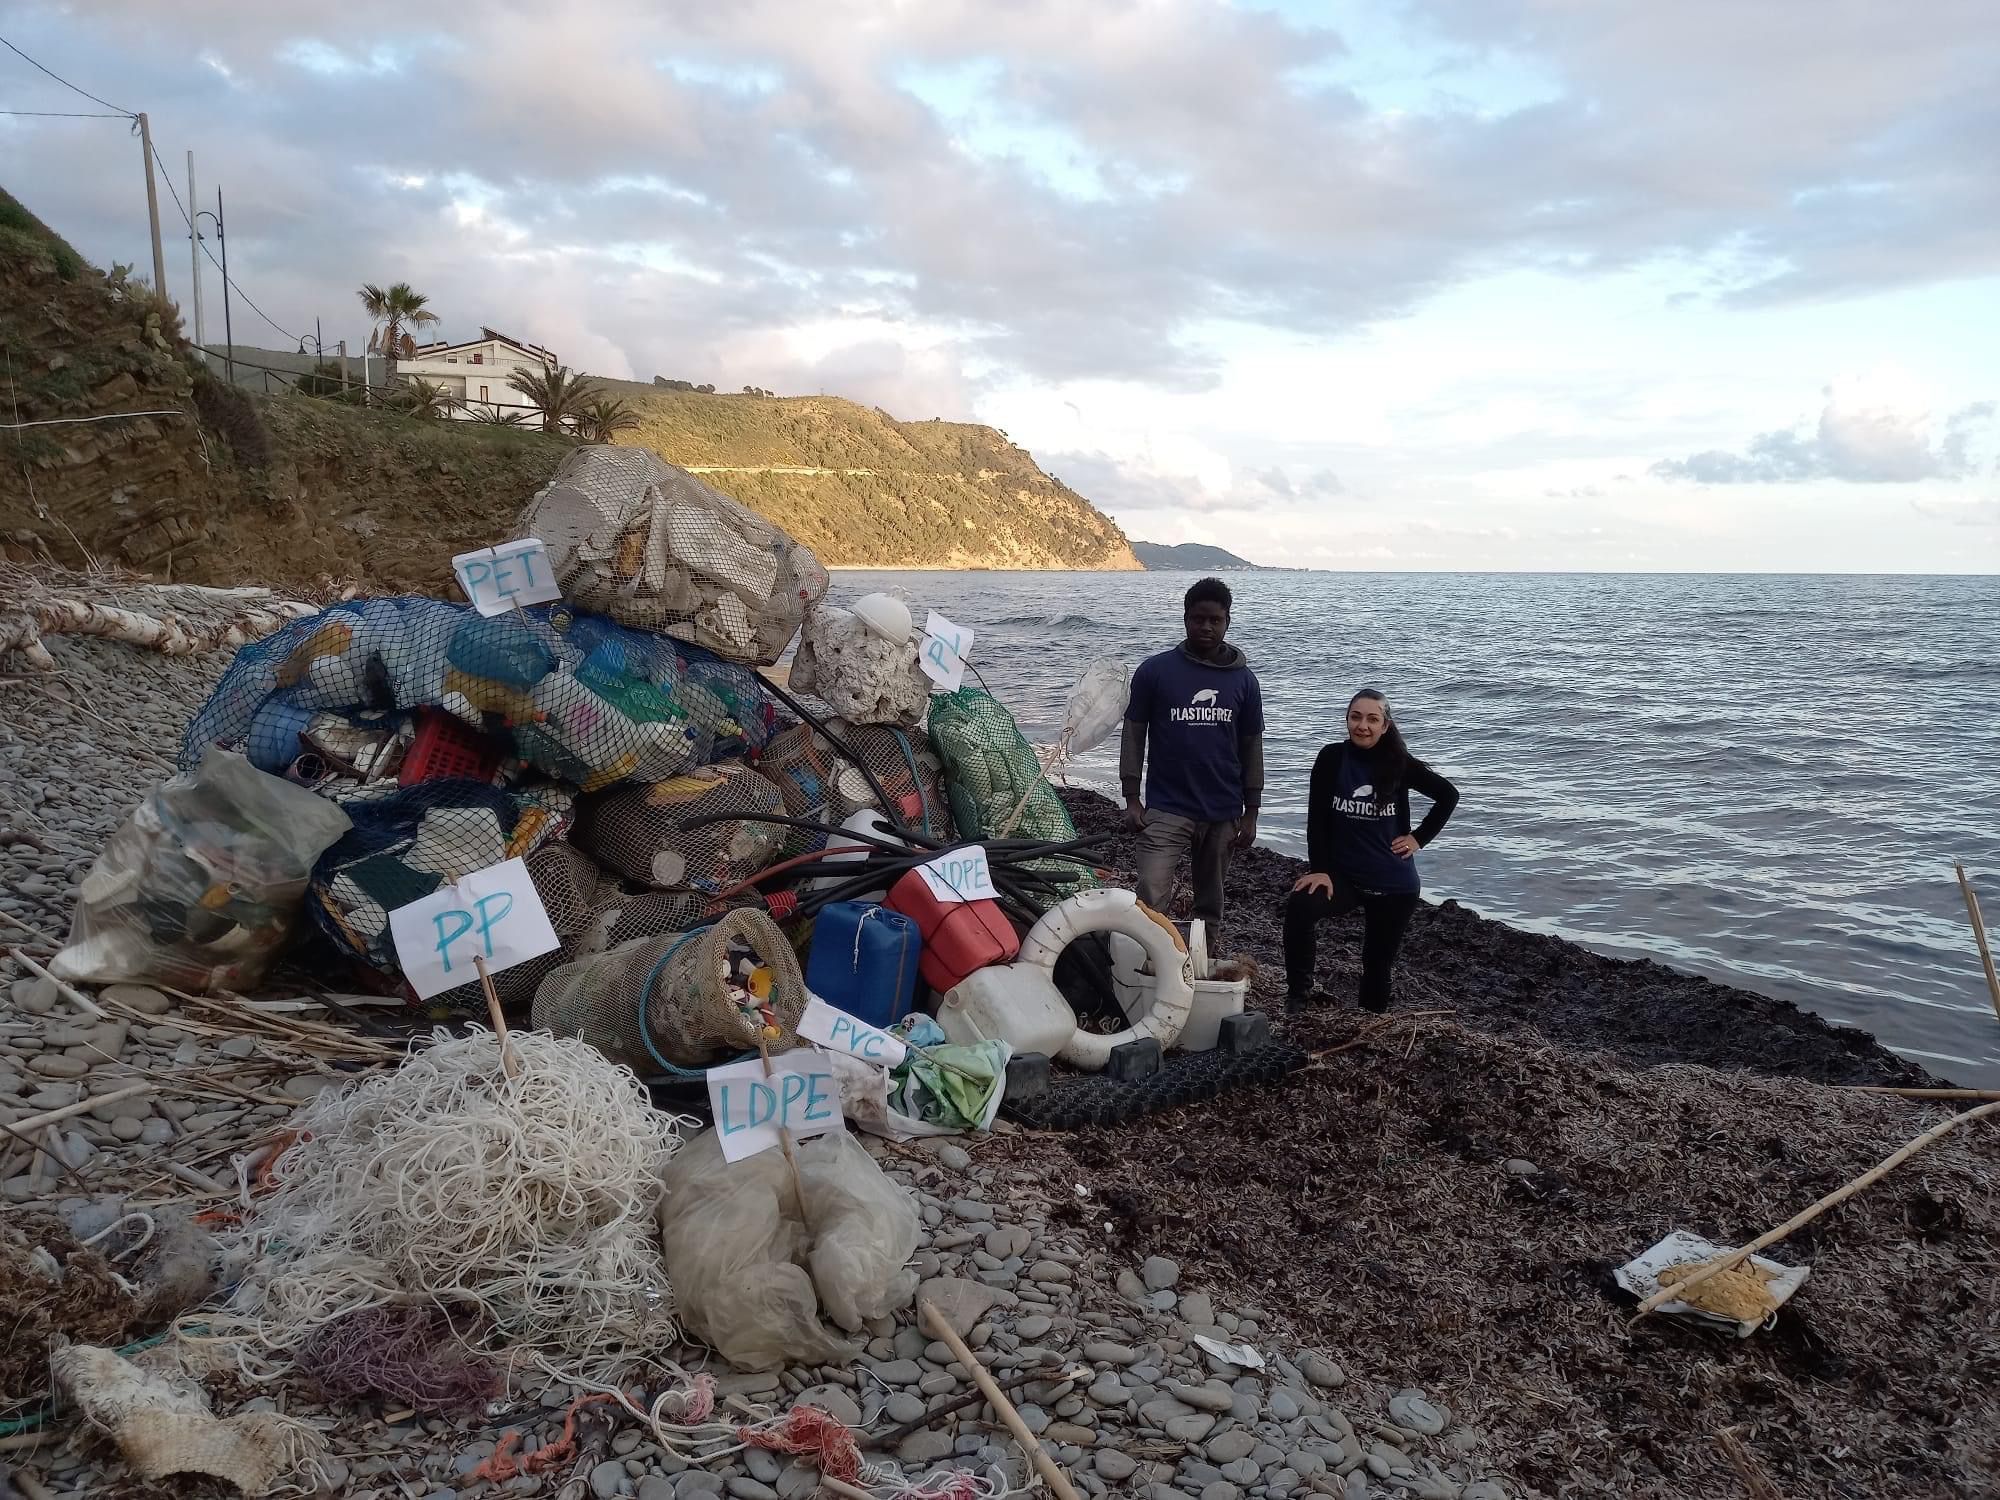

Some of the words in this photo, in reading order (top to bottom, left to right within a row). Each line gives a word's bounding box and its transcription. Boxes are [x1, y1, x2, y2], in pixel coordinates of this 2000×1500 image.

[464, 551, 537, 605] PET
[930, 858, 989, 890] HDPE
[432, 892, 513, 973] PP
[830, 1016, 885, 1057] PVC
[721, 1072, 833, 1137] LDPE
